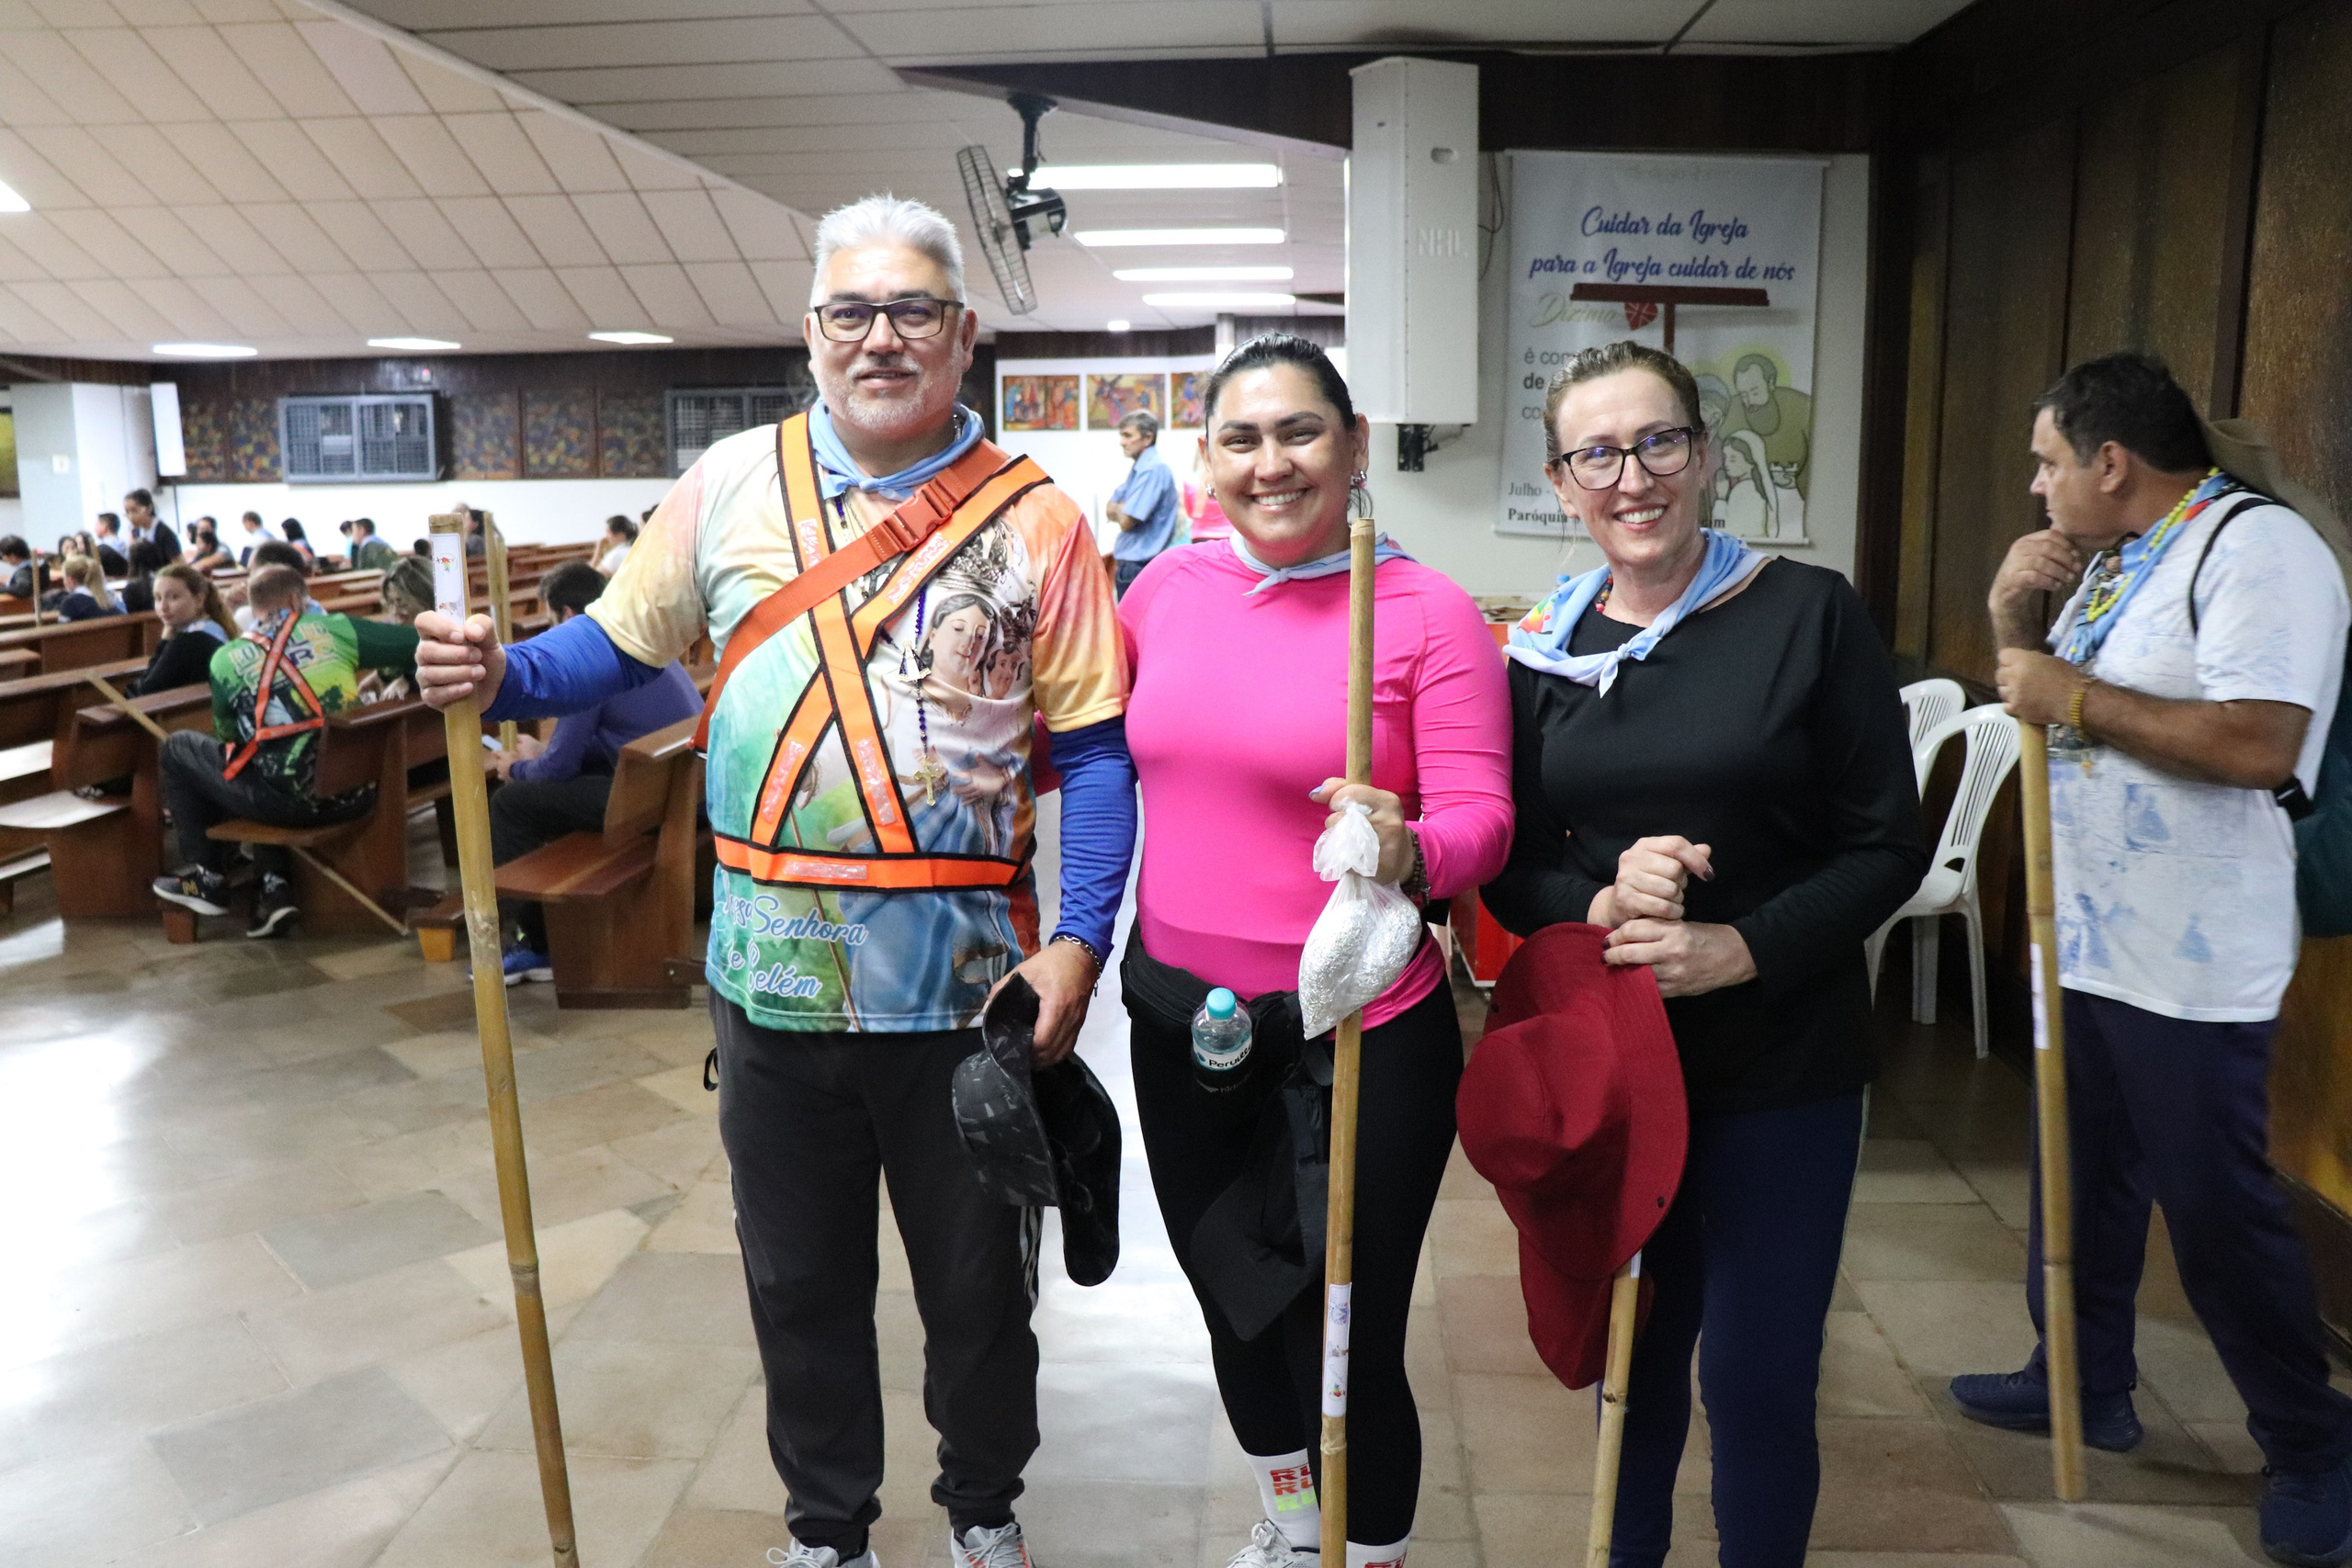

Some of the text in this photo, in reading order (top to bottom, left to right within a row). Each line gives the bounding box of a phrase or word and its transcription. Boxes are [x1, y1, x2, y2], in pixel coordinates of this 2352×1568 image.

[1580, 205, 1750, 245] Cuidar da Igreja
[1528, 247, 1797, 284] para a Igreja cuidar de nós
[1523, 346, 1535, 365] é
[1522, 372, 1545, 390] de
[1508, 481, 1543, 498] Julho
[752, 894, 870, 946] Senhora
[746, 938, 824, 999] elém
